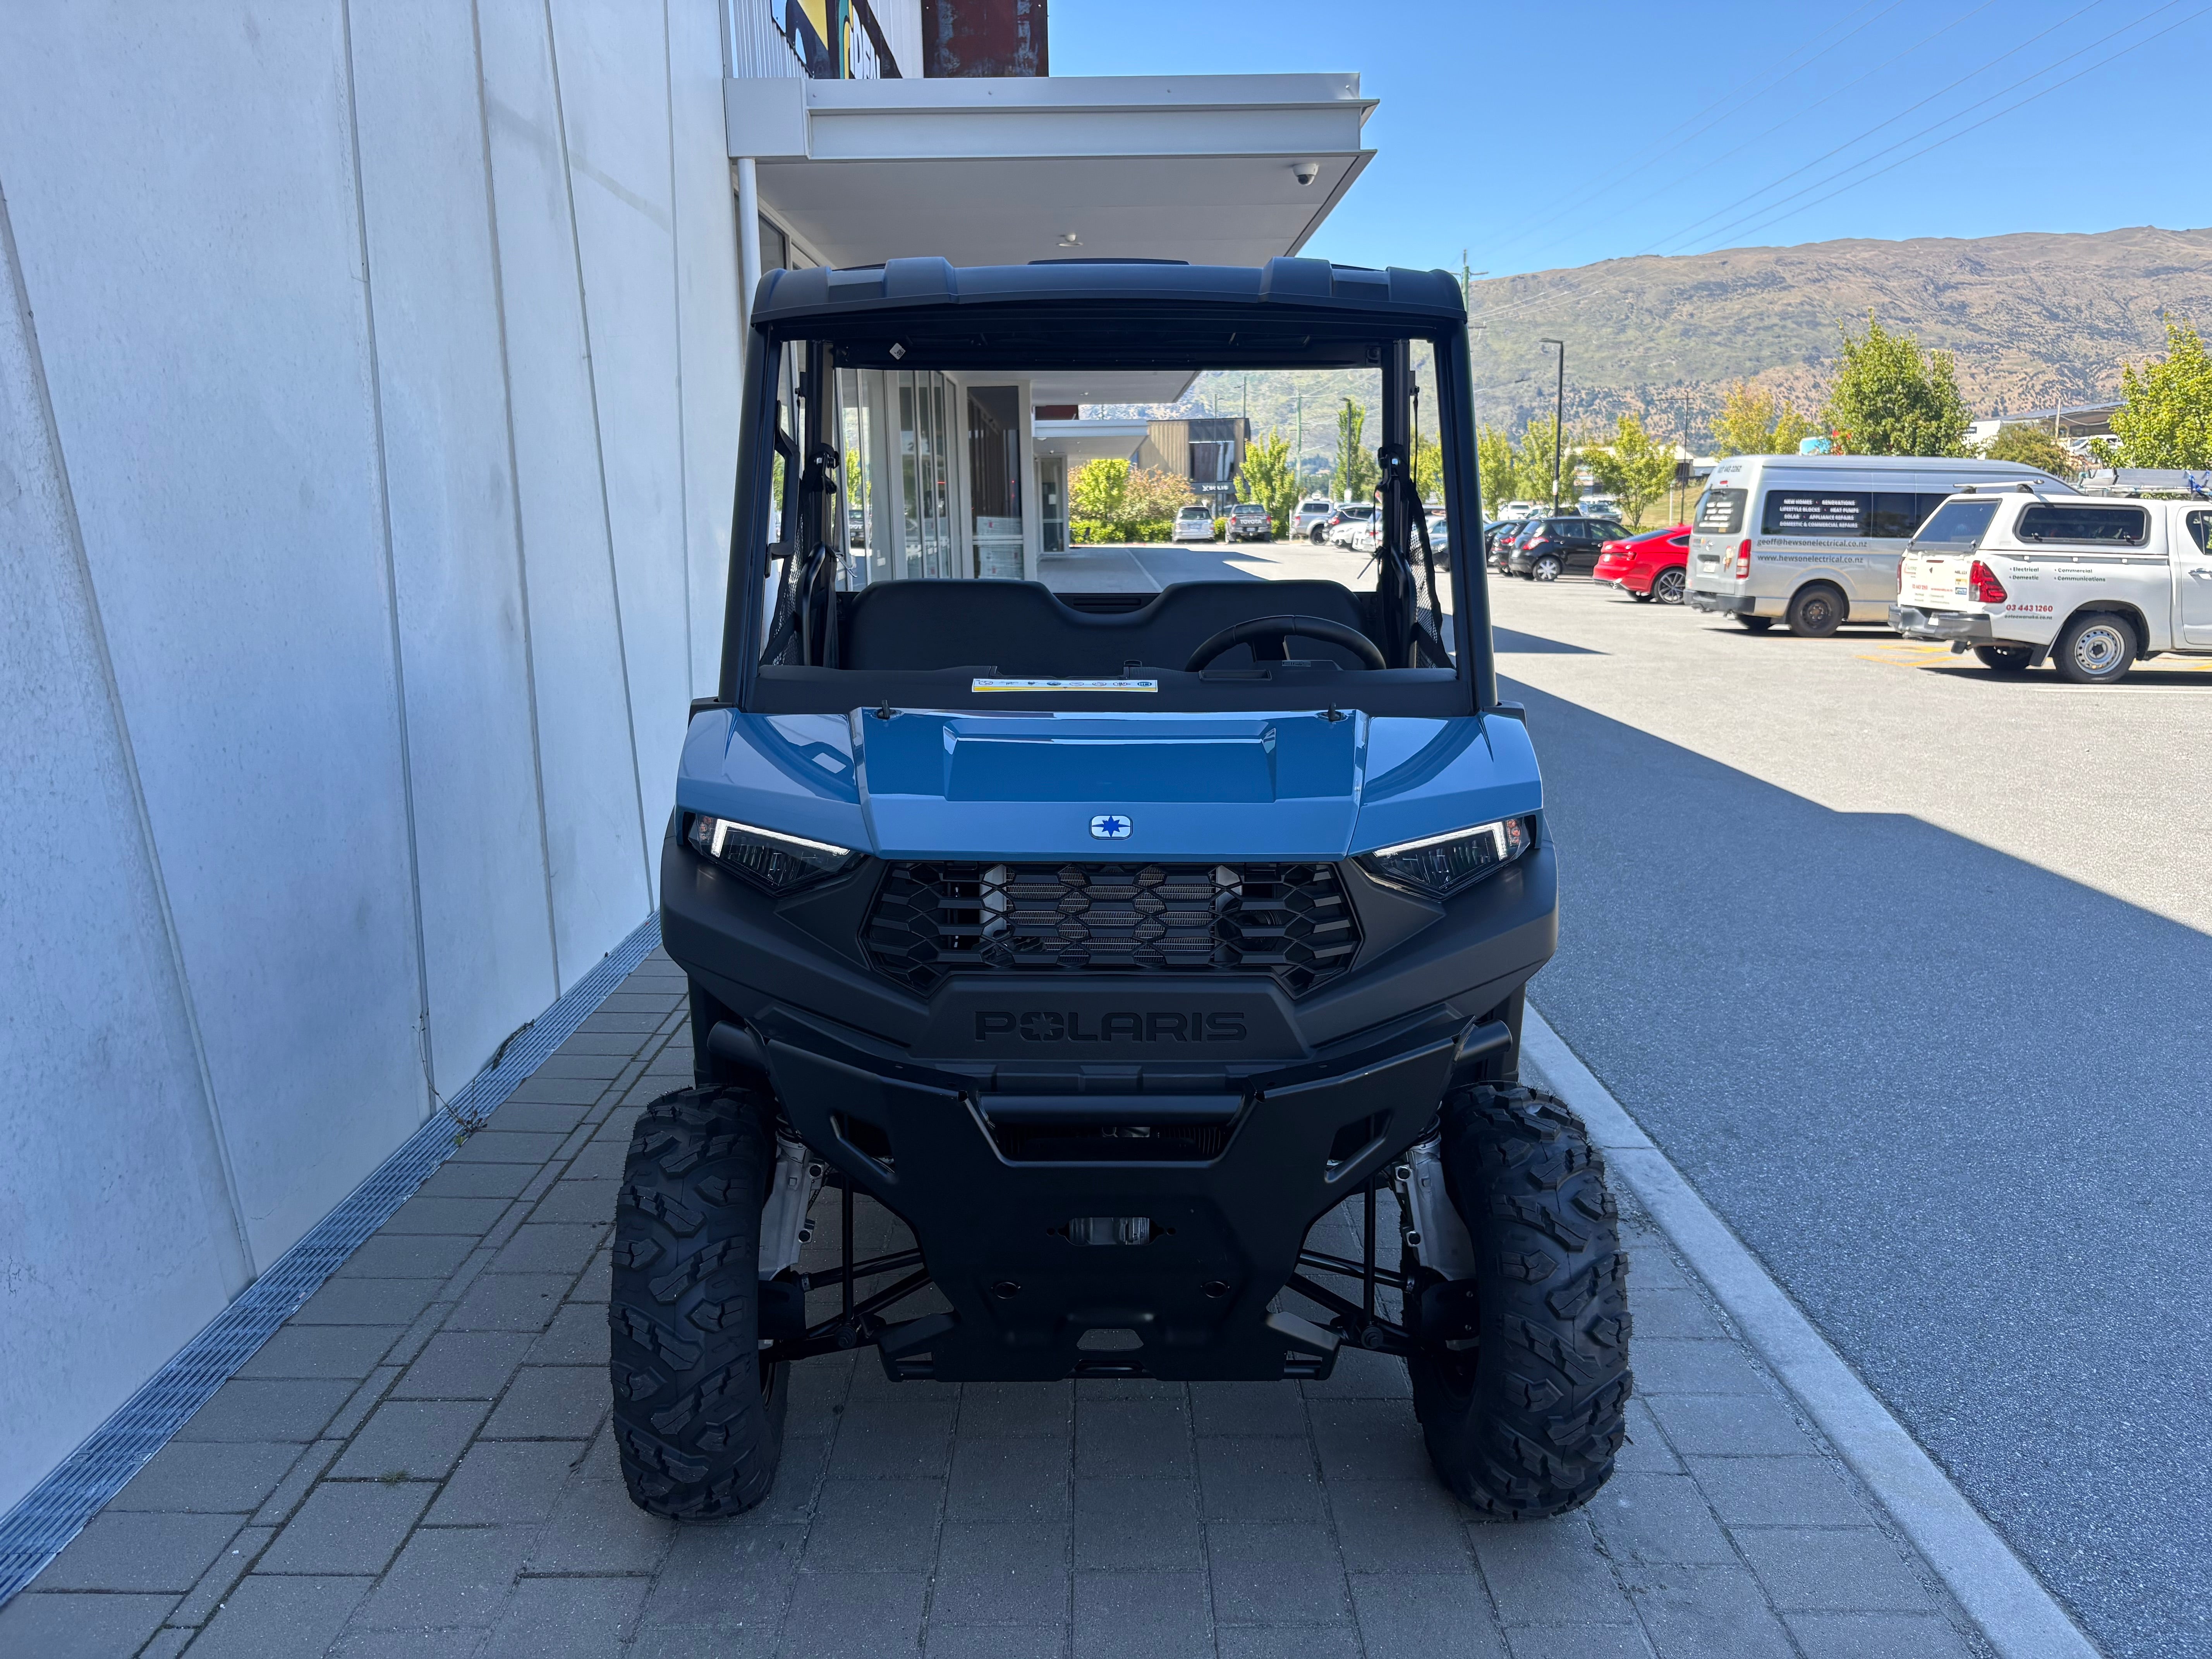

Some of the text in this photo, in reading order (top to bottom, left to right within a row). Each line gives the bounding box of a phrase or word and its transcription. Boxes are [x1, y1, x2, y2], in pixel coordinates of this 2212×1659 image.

[1757, 538, 1867, 547] geoff@hewsonelectrical.co.nz
[1757, 554, 1864, 563] www.hewsonelectrical.co.nz
[974, 1011, 1247, 1042] POLARIS
